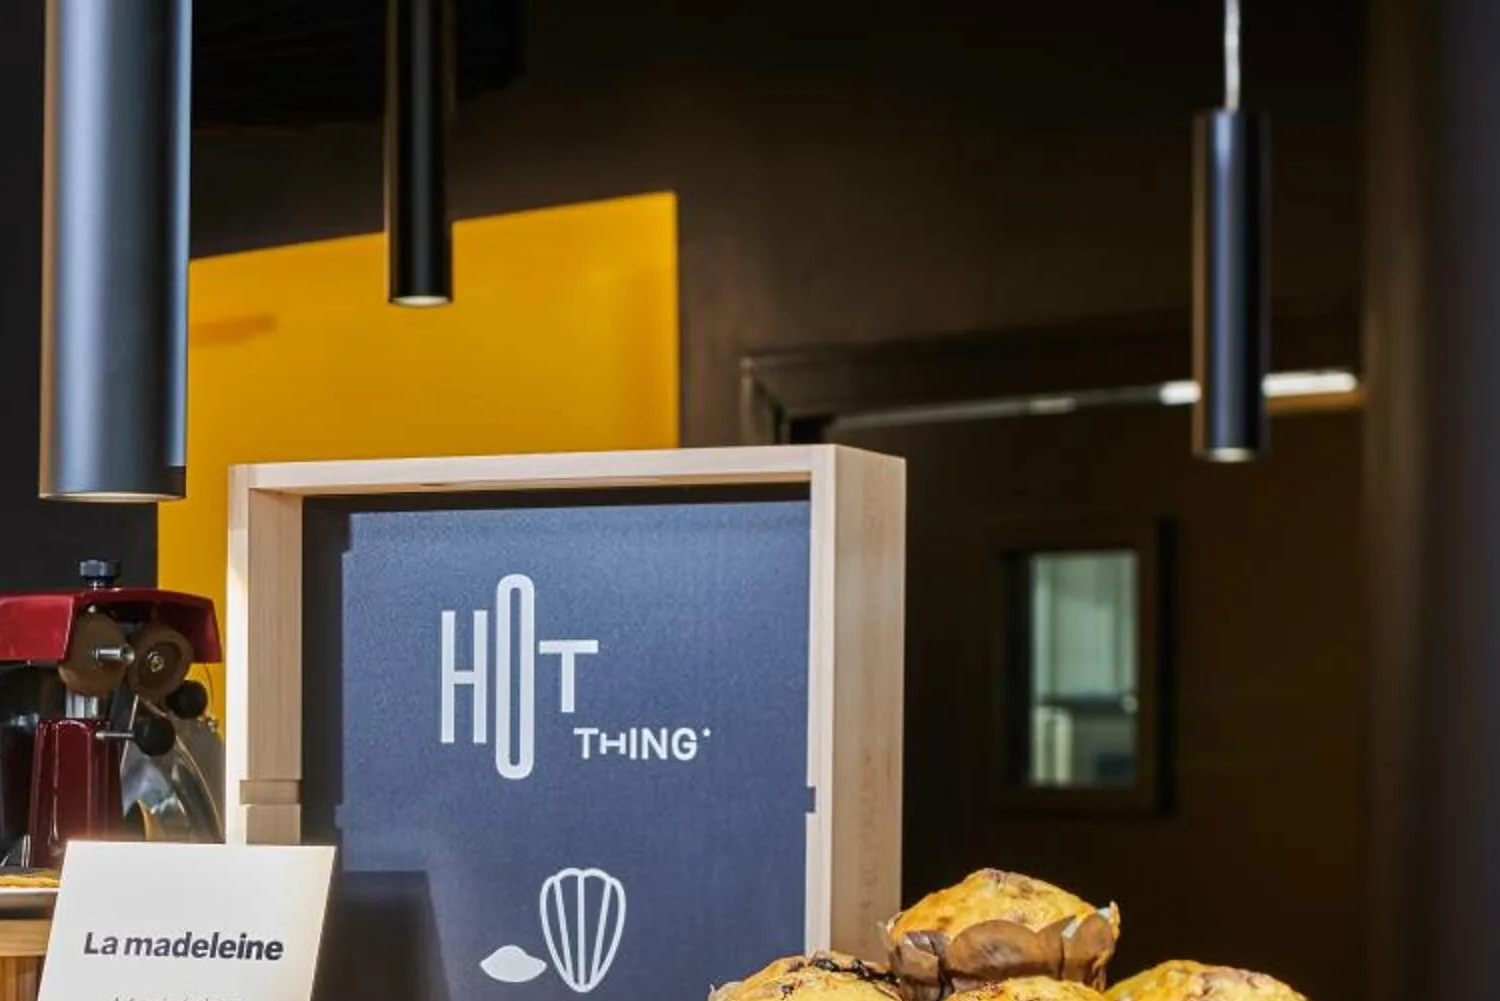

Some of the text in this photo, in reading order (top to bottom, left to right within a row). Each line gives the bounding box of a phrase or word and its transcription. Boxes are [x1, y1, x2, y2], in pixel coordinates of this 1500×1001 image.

[441, 573, 599, 780] HOT
[83, 931, 284, 961] La madeleine
